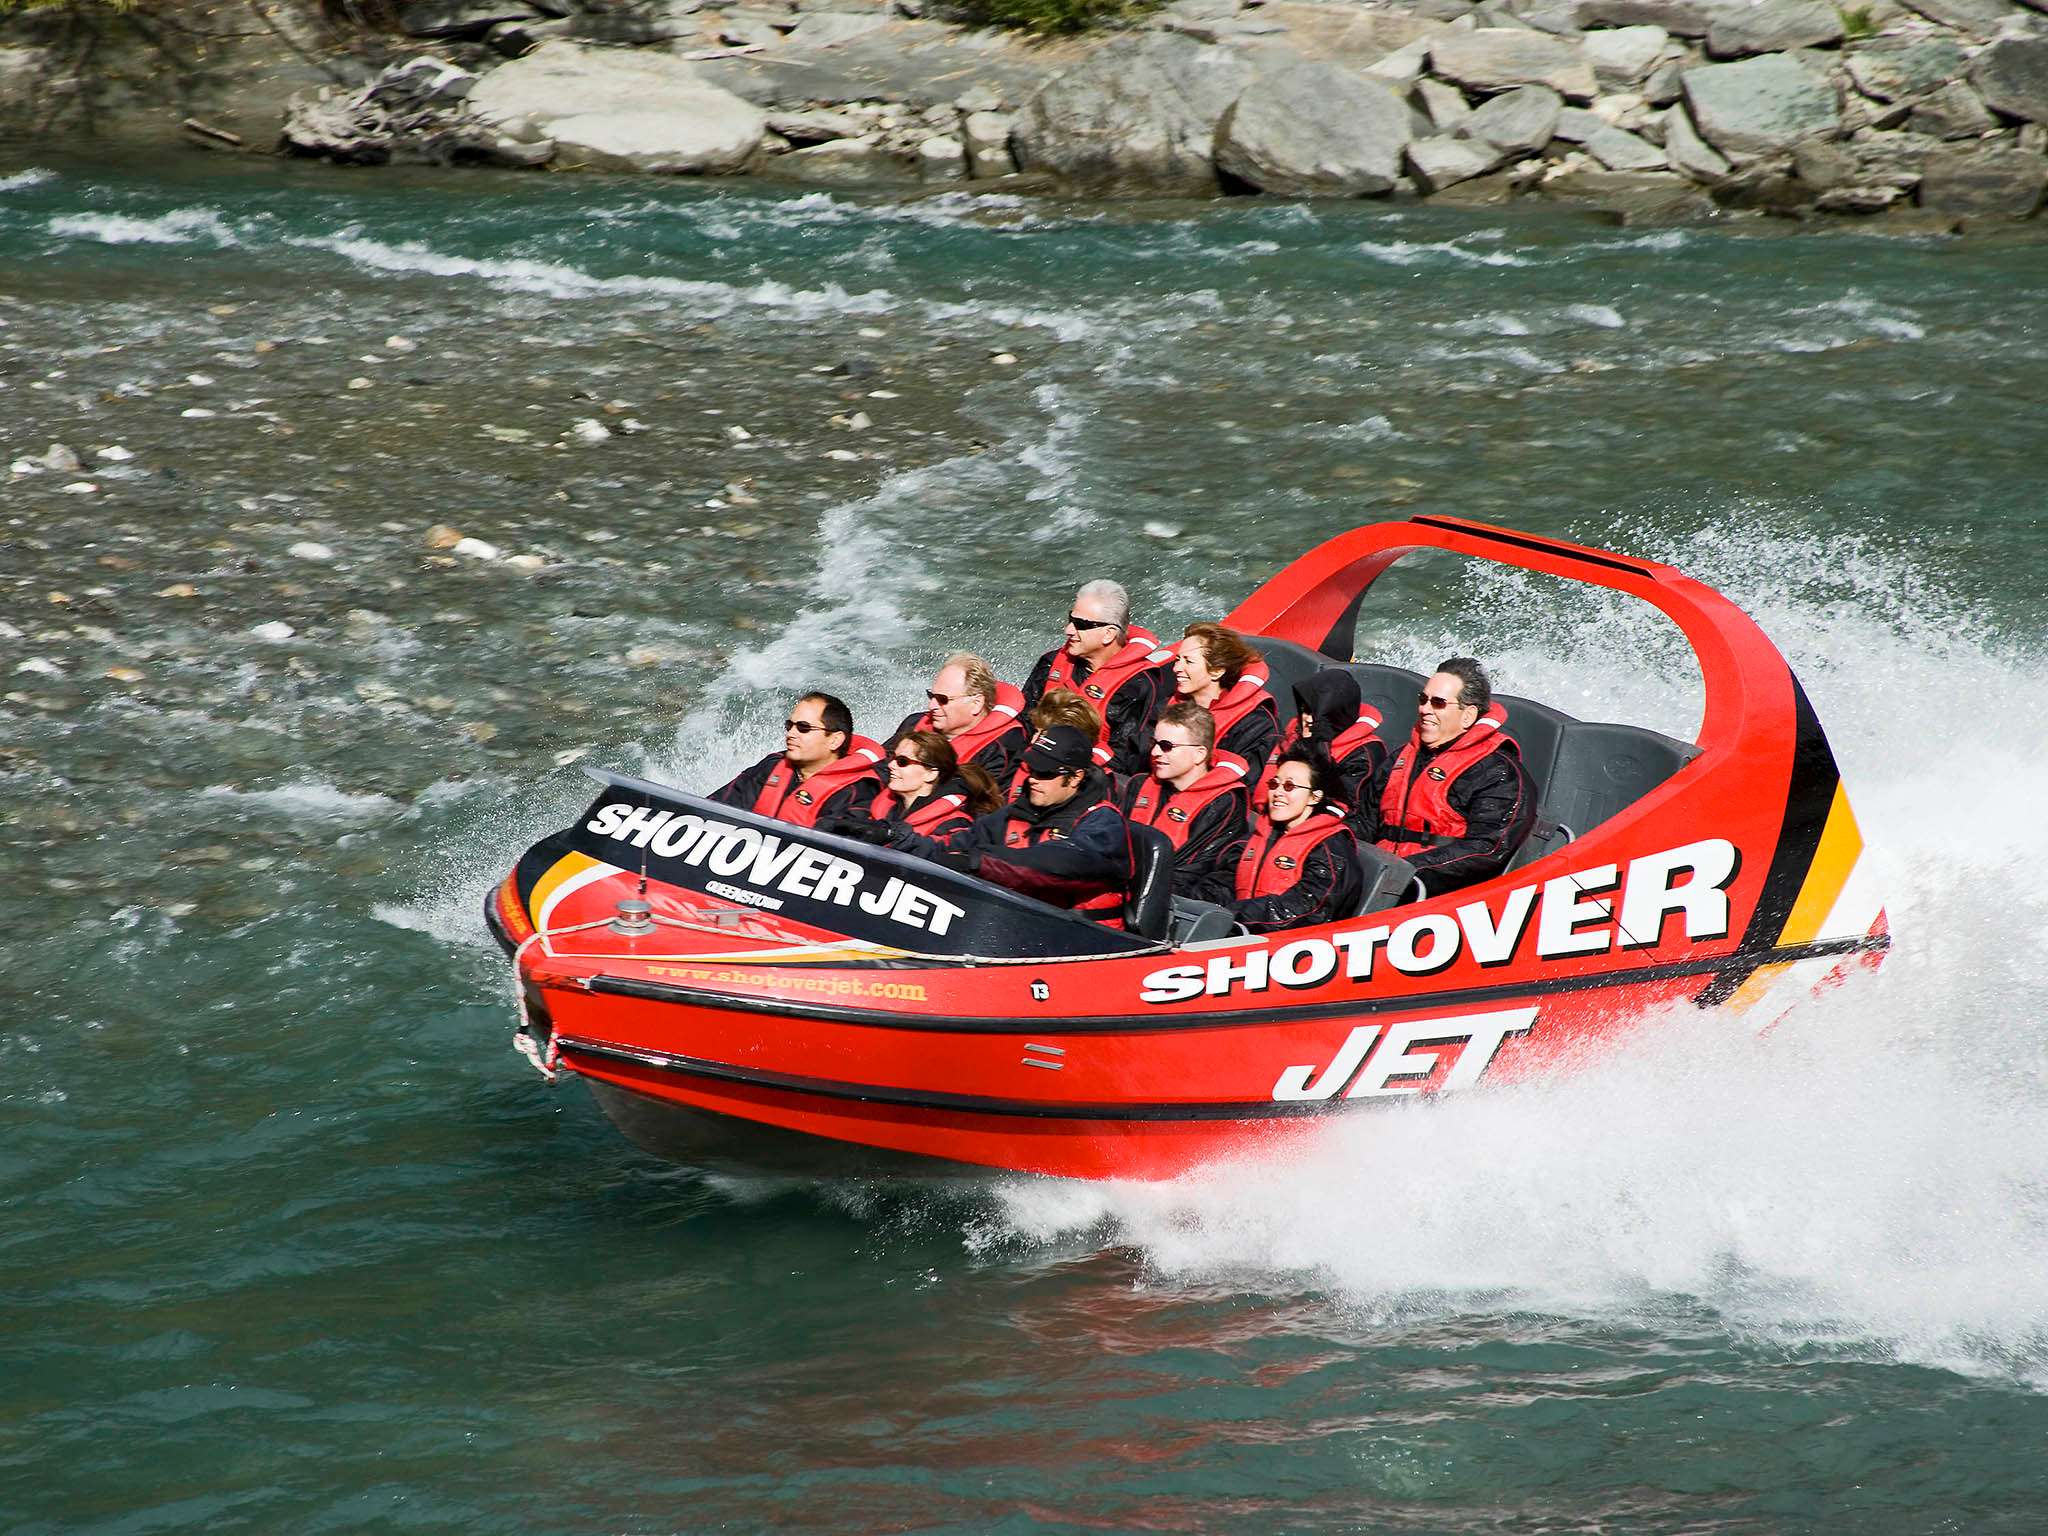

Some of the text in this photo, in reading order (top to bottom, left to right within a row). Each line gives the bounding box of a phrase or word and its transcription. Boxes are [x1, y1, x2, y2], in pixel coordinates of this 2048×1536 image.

[586, 803, 966, 936] SHOTOVER JET
[1140, 838, 1739, 1004] SHOTOVER
[646, 964, 929, 1002] www.shotoverjet.com
[1030, 983, 1050, 1000] 13
[1271, 1006, 1541, 1102] JET
